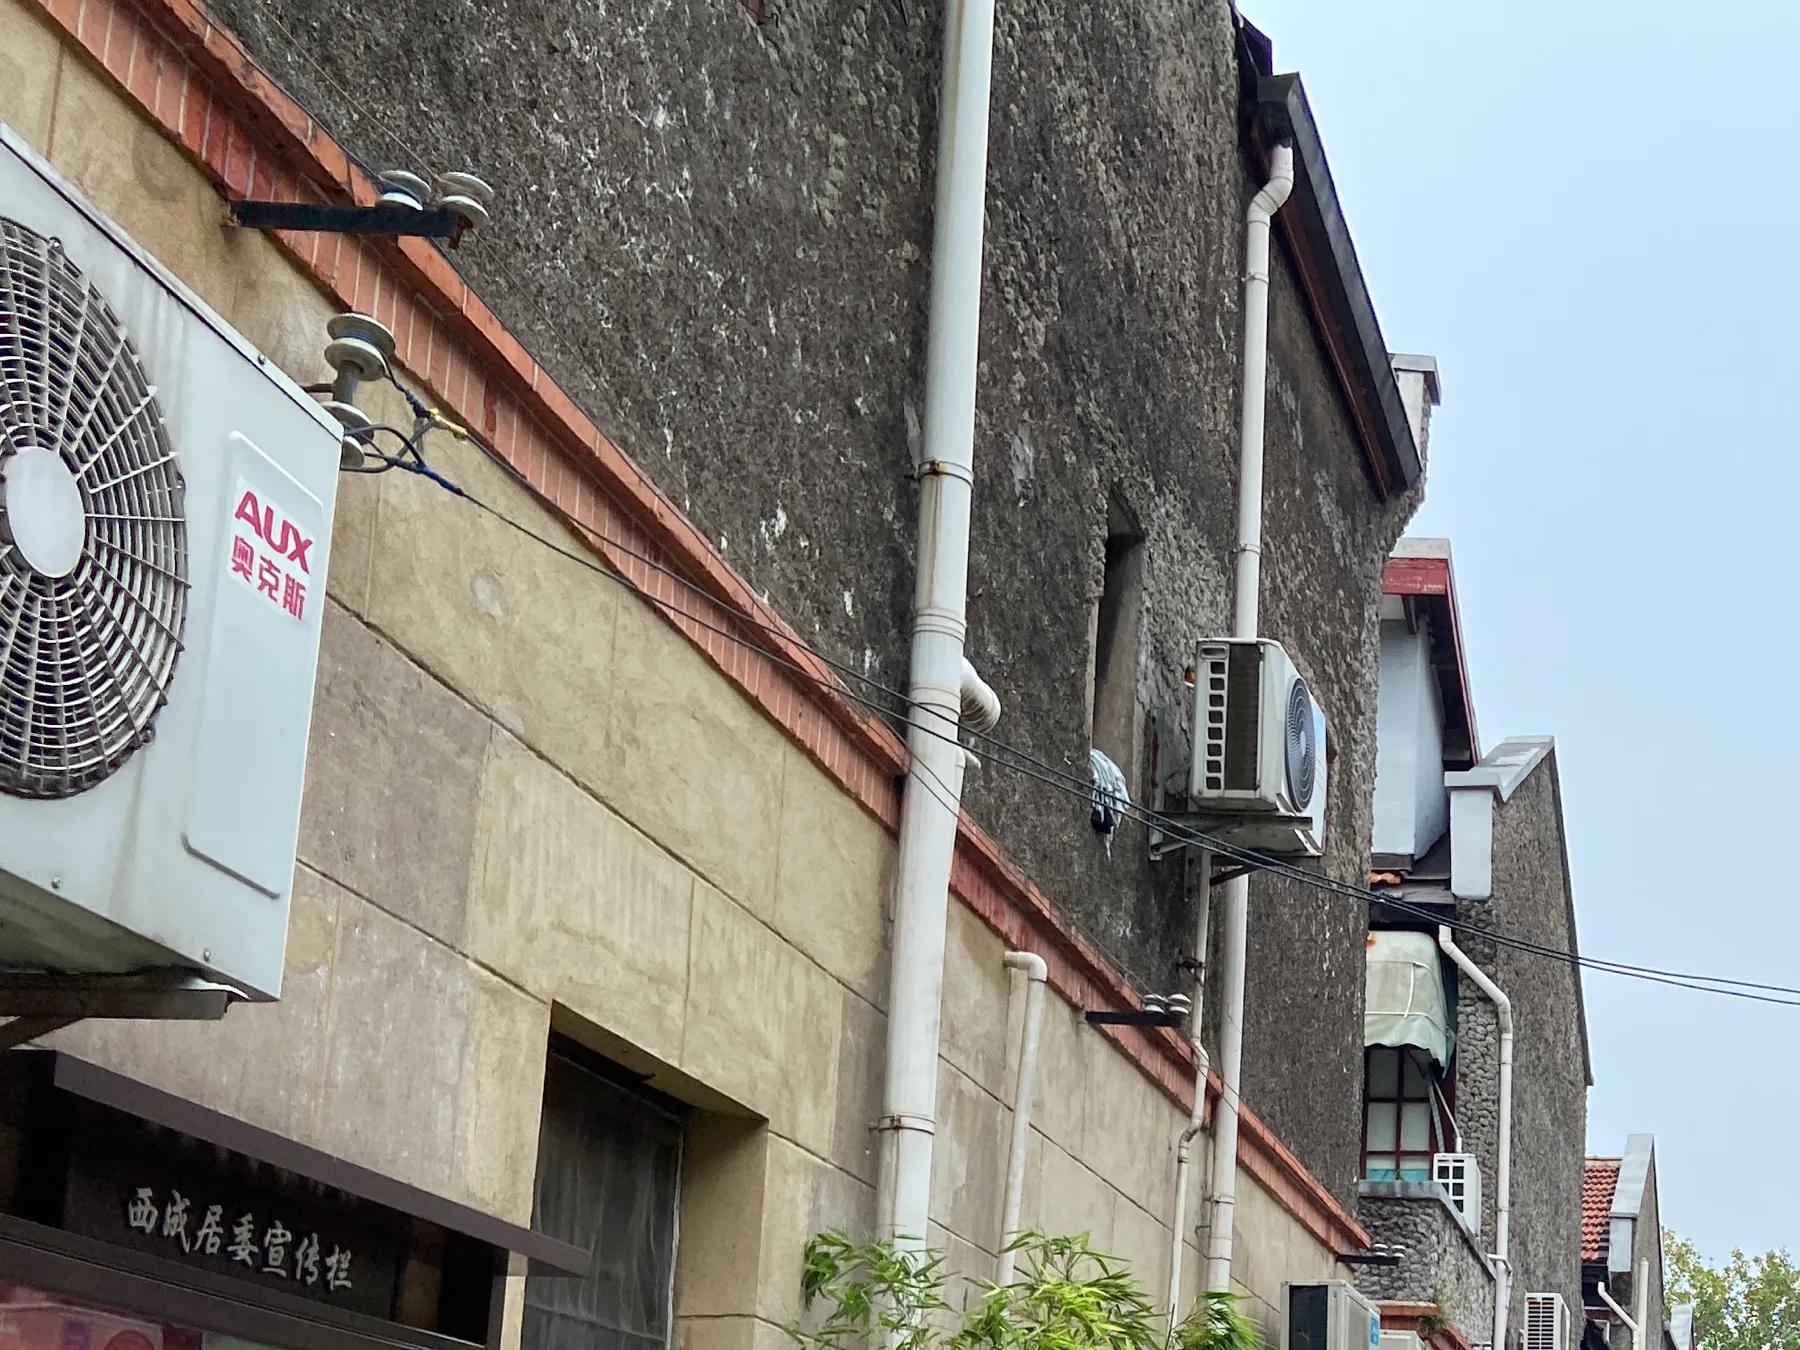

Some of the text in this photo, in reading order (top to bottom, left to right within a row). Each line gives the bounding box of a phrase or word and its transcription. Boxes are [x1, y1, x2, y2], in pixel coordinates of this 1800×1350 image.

[235, 491, 313, 575] AUX
[231, 535, 306, 620] 奥克斯
[128, 1187, 352, 1290] 西成居委宣传栏
